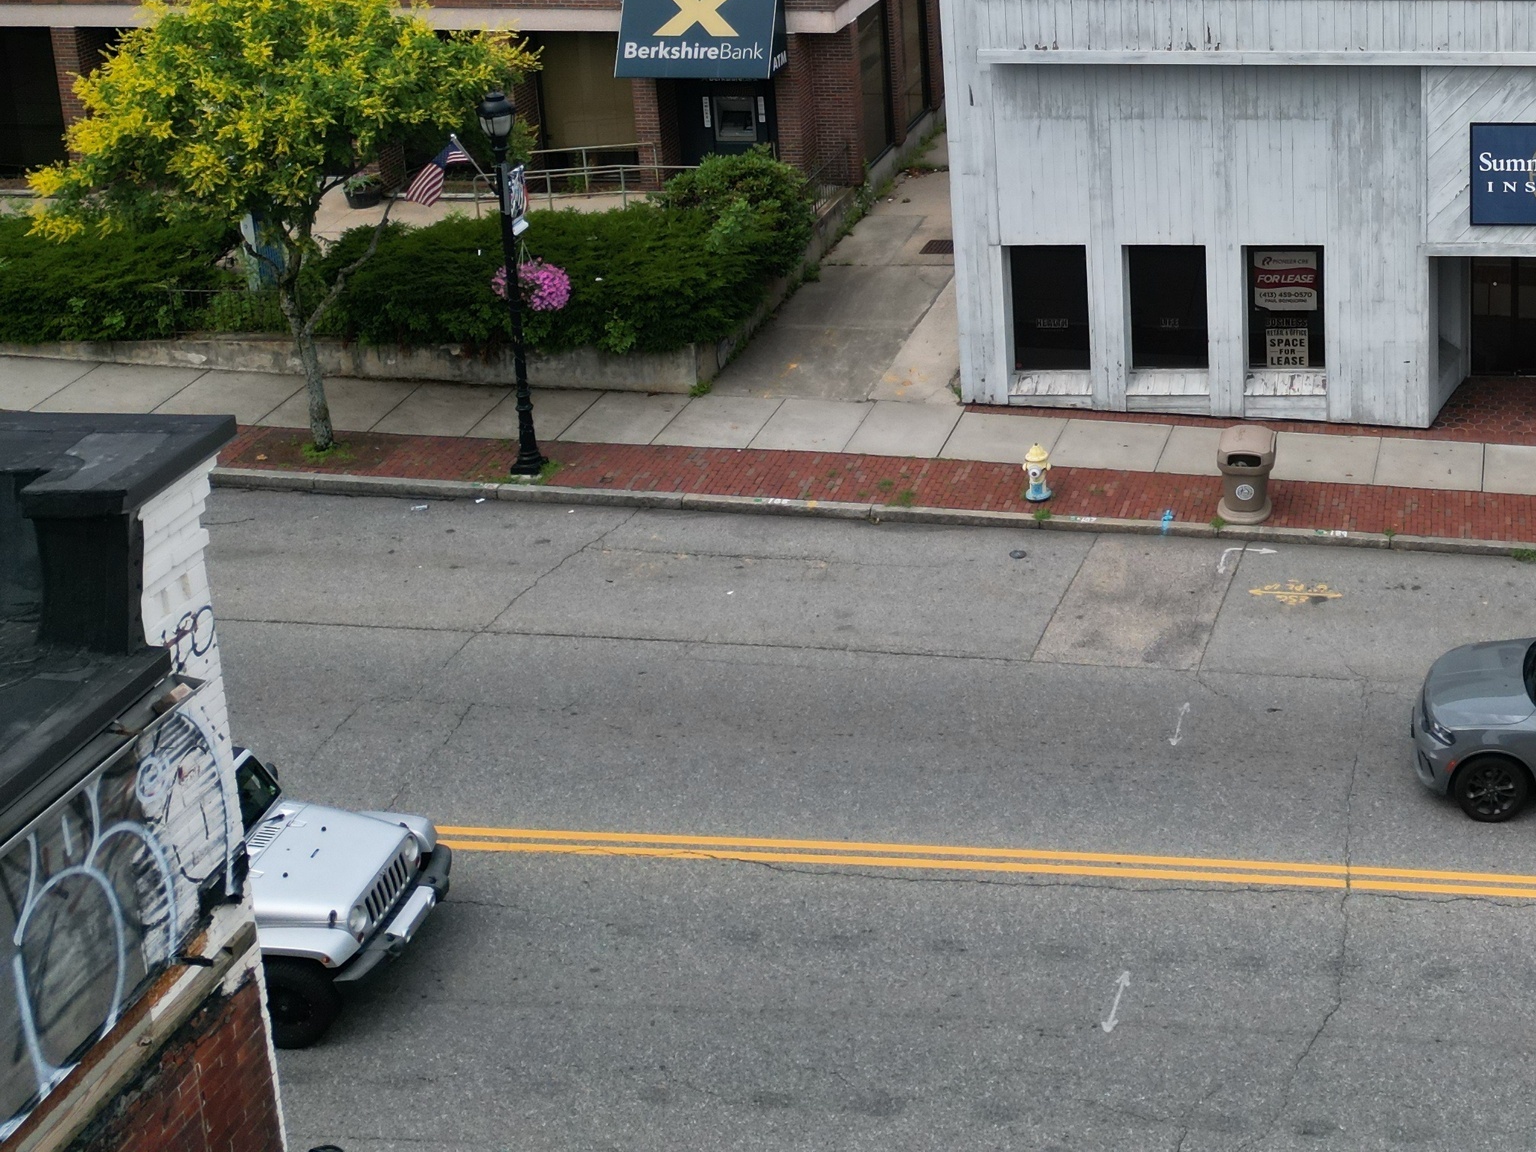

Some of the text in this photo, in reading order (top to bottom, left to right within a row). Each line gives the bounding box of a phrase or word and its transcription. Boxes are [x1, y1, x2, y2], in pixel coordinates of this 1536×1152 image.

[624, 41, 763, 60] BerkshireBank
[773, 50, 787, 71] ATM
[1257, 275, 1315, 283] FOR LEASE
[1270, 339, 1305, 347] SPACE
[1271, 357, 1305, 366] LEASE
